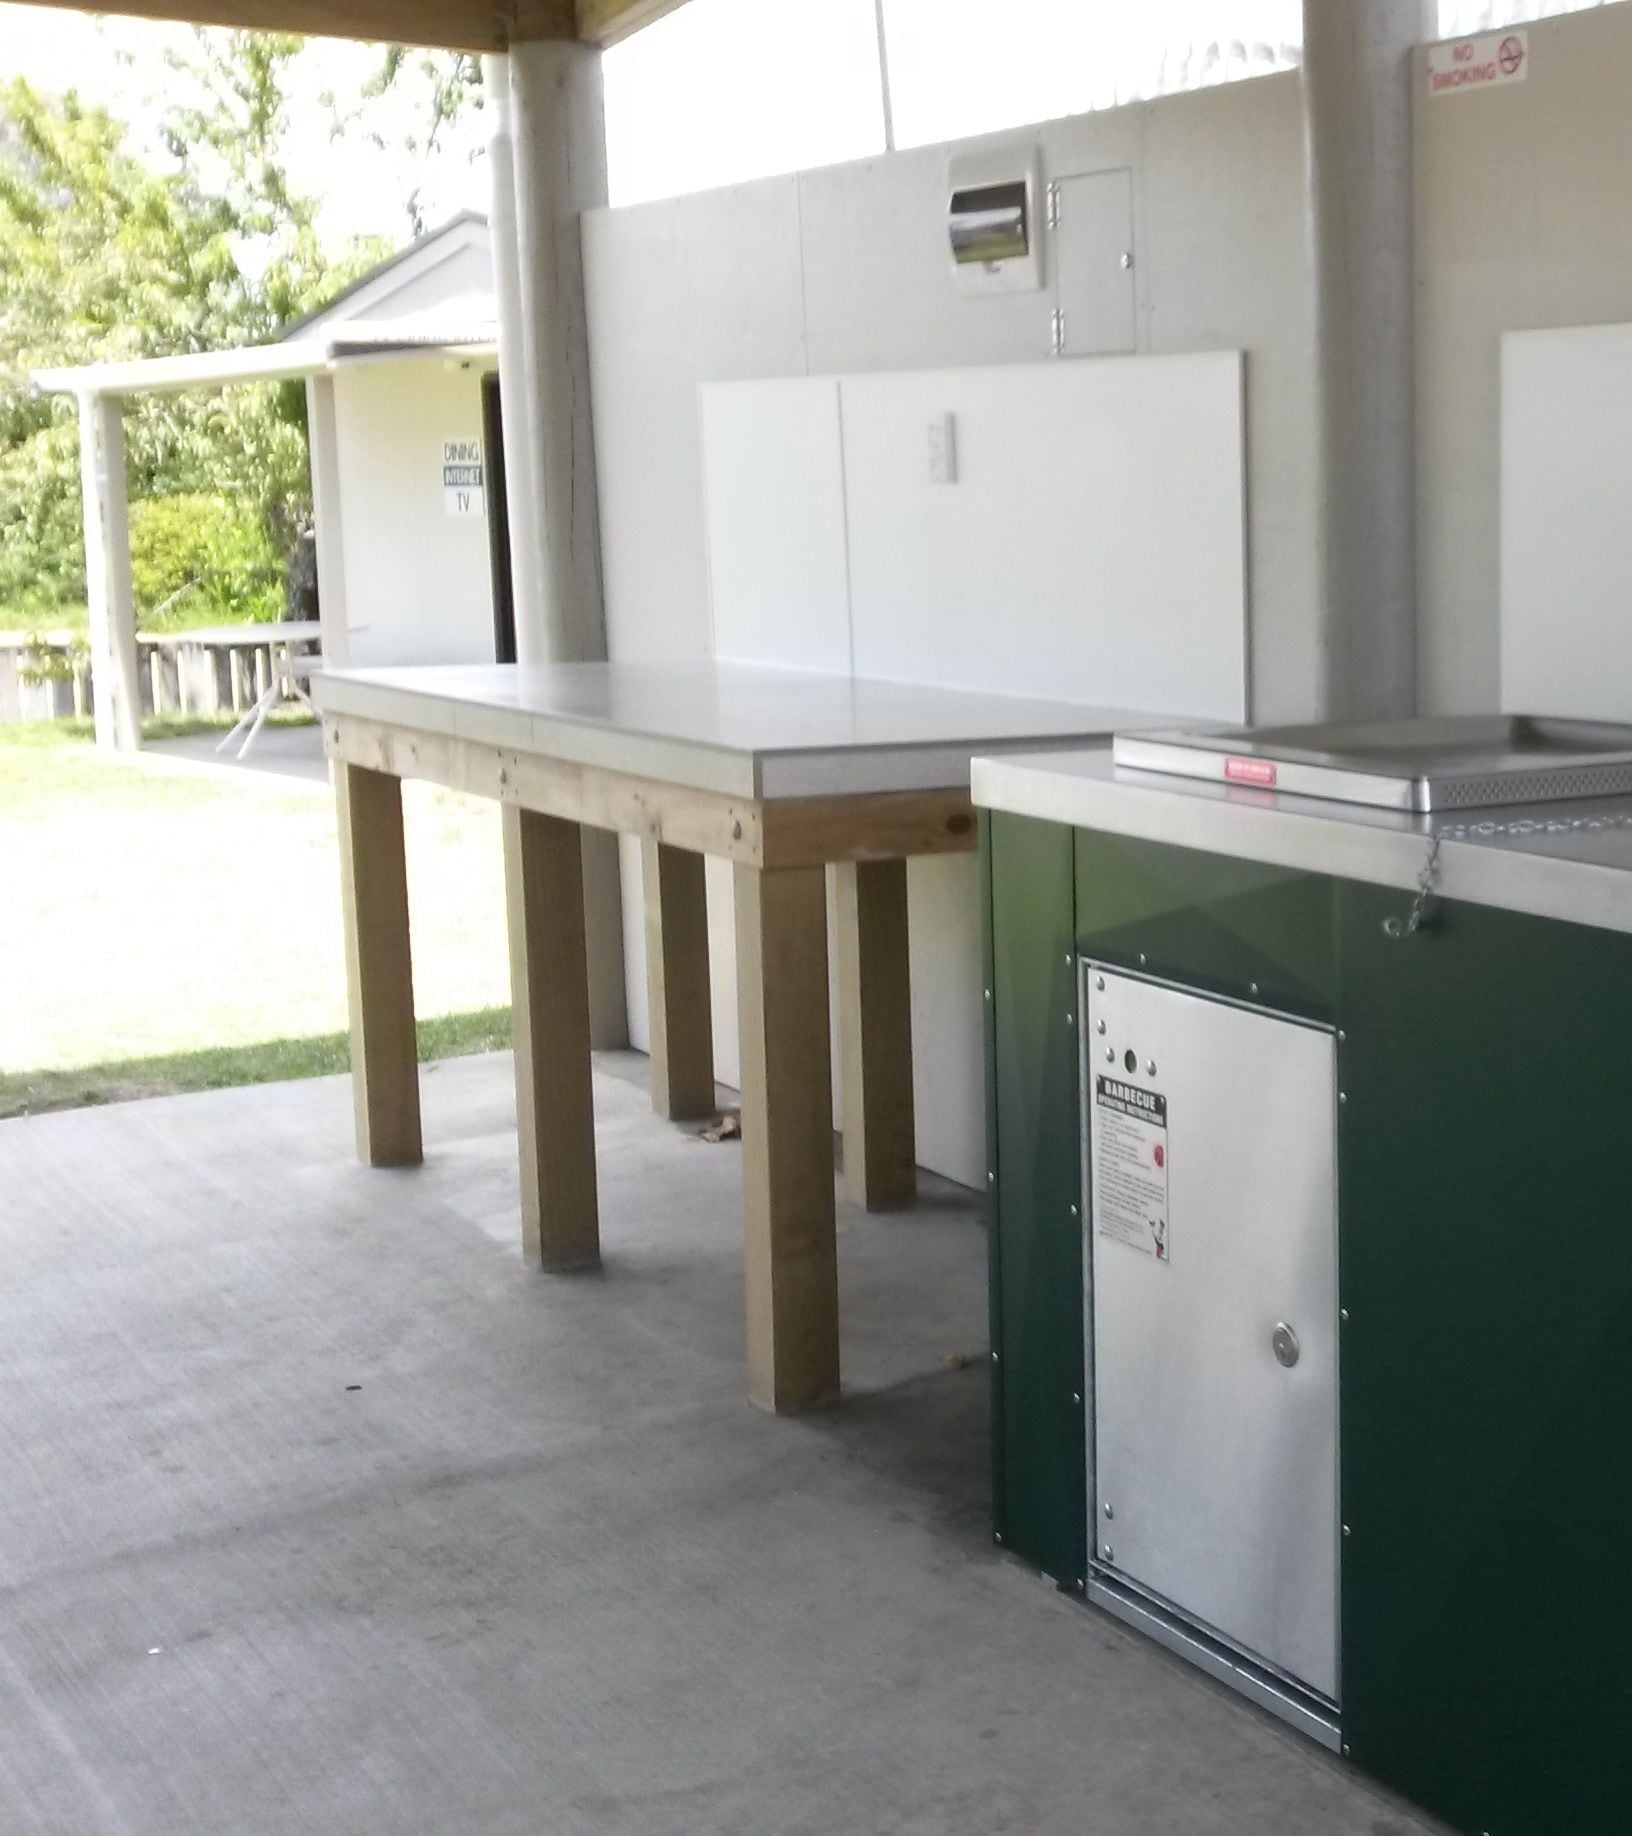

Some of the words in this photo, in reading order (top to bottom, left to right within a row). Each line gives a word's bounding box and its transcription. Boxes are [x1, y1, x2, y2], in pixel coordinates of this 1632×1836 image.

[1453, 43, 1474, 62] NO
[1432, 61, 1496, 91] SMOKING
[444, 442, 479, 462] DINING
[456, 492, 470, 513] TV
[1104, 1079, 1157, 1112] BARBECUE
